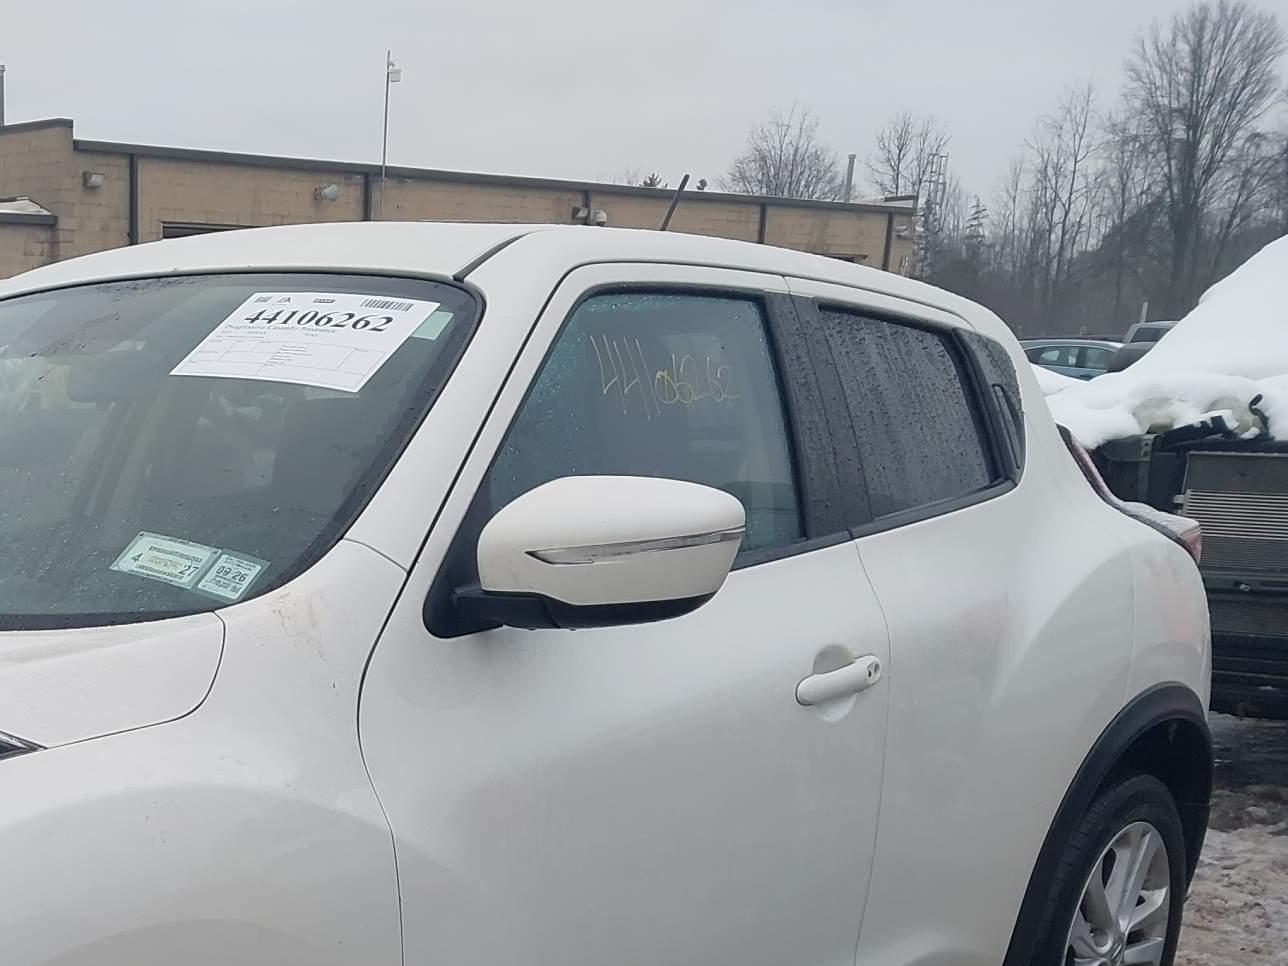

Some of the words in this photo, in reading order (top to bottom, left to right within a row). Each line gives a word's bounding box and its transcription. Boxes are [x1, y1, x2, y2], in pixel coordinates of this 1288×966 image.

[243, 308, 394, 332] 44106262
[178, 564, 199, 577] 27
[216, 565, 232, 577] 09
[232, 570, 249, 582] 26
